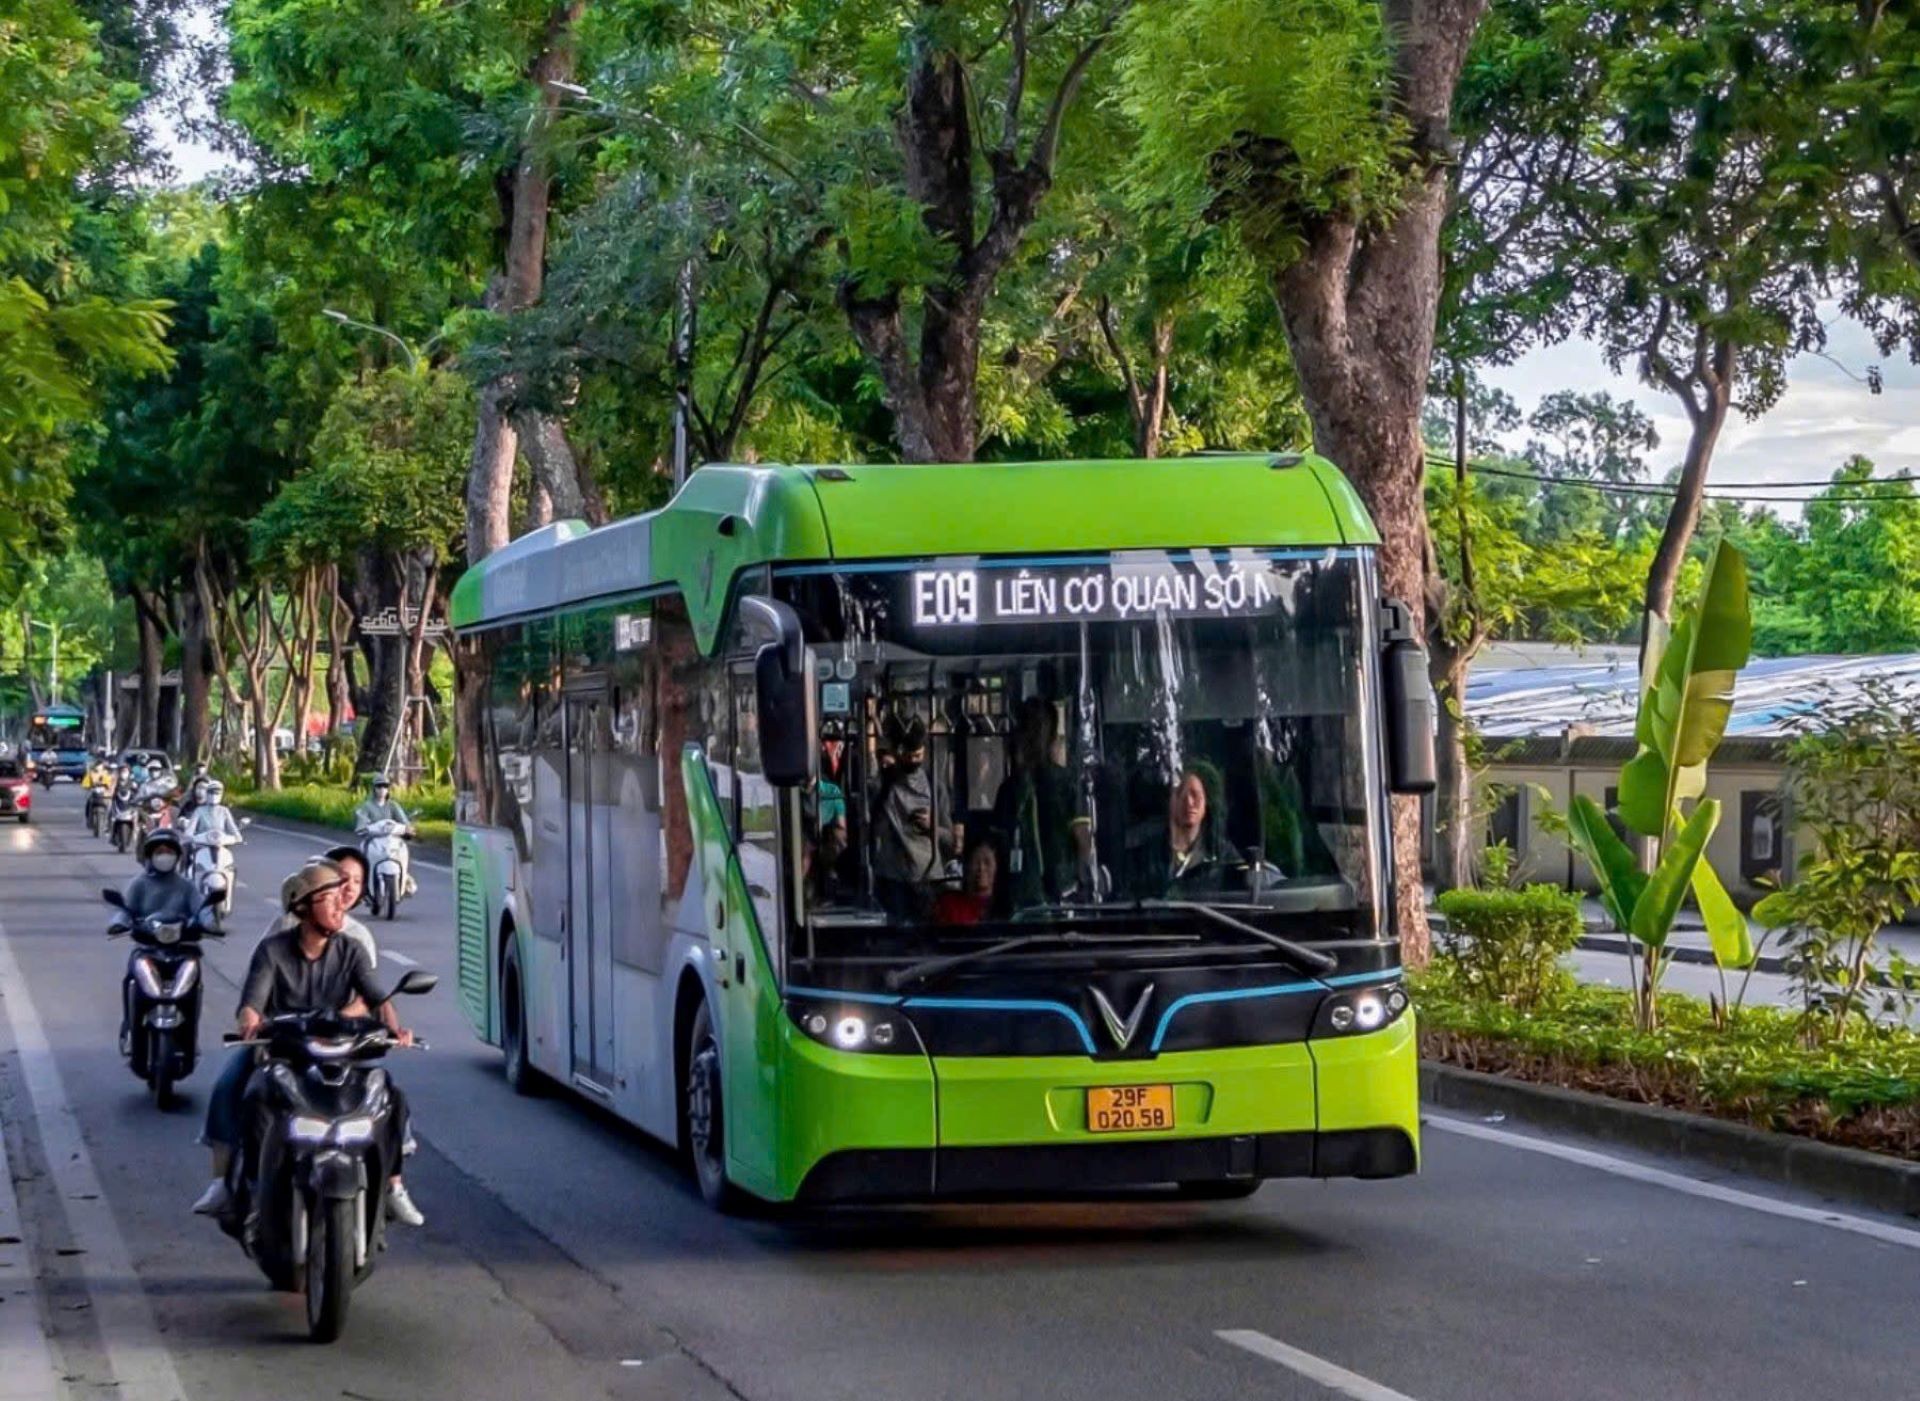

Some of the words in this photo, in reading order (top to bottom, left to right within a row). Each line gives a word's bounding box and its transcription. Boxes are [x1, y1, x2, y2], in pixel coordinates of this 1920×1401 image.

[914, 571, 978, 624] E09
[995, 568, 1055, 616] LIÊN
[1064, 573, 1104, 614] CƠ
[1111, 573, 1196, 618] QUAN
[1204, 562, 1246, 610] SỞ
[1112, 1087, 1147, 1108] 29F
[1097, 1108, 1165, 1129] 020.58
